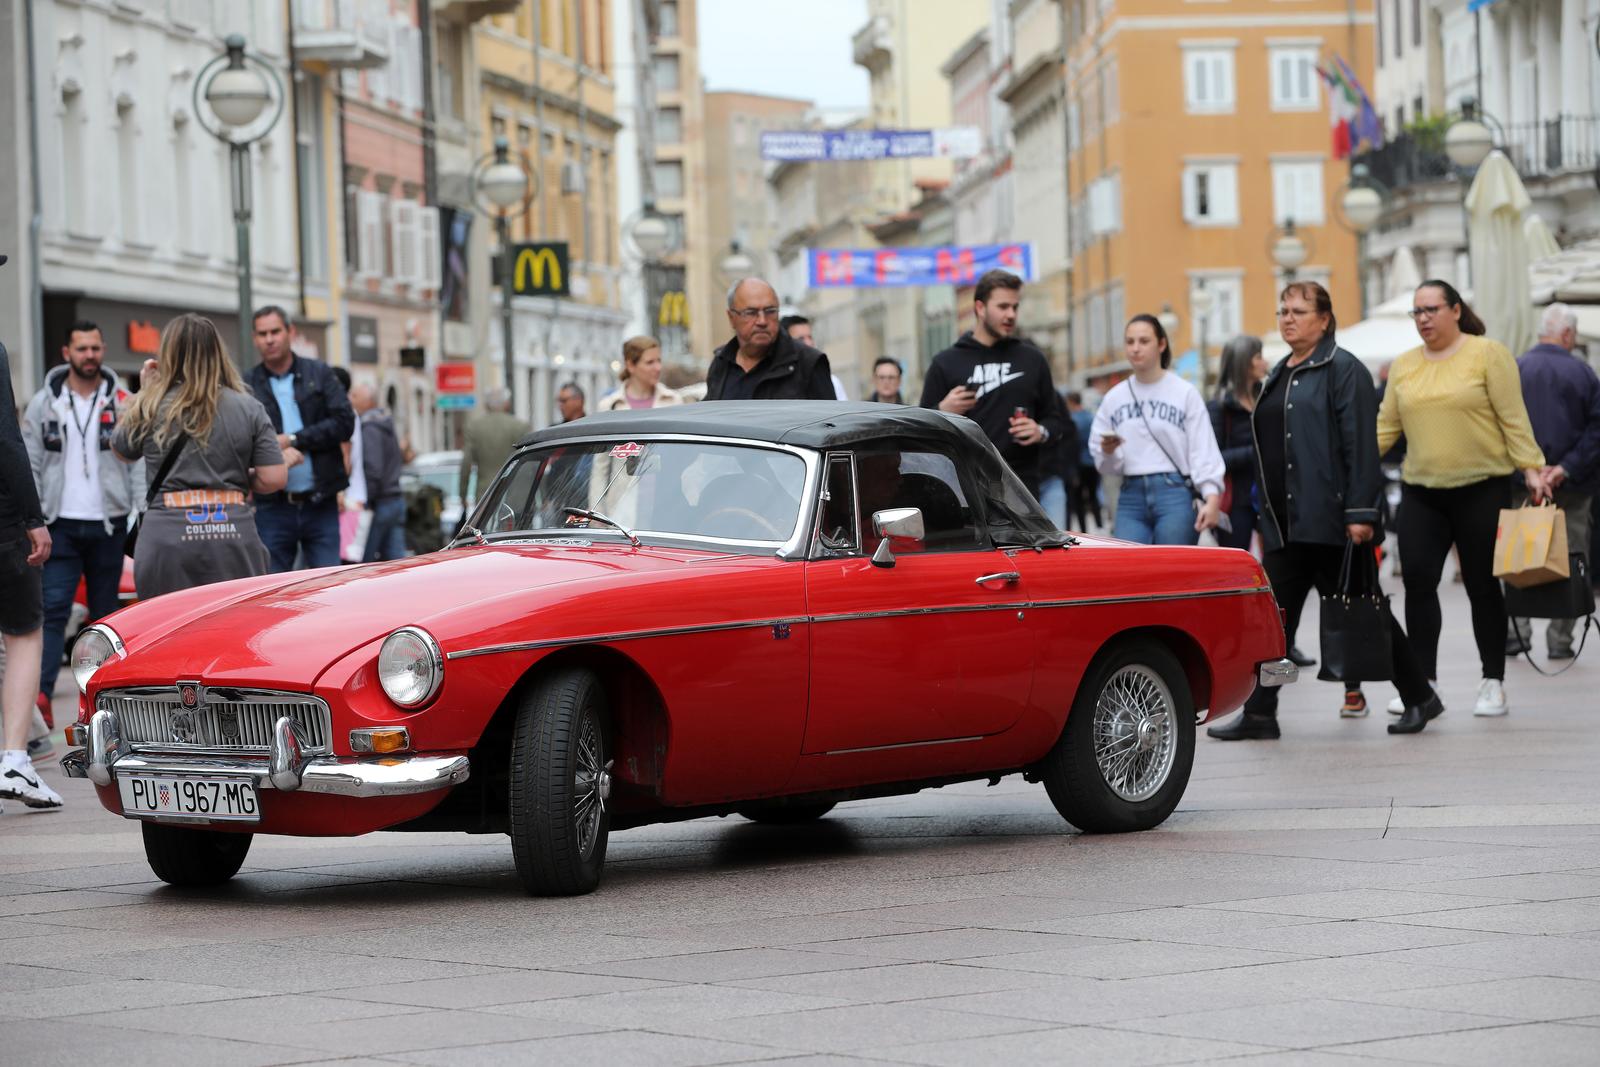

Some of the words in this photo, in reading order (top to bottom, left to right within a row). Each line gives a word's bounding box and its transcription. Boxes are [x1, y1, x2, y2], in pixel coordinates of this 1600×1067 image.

[1110, 400, 1144, 431] NEW
[1149, 399, 1187, 432] YORK
[185, 523, 237, 535] COLUMBIA
[132, 779, 158, 810] PU
